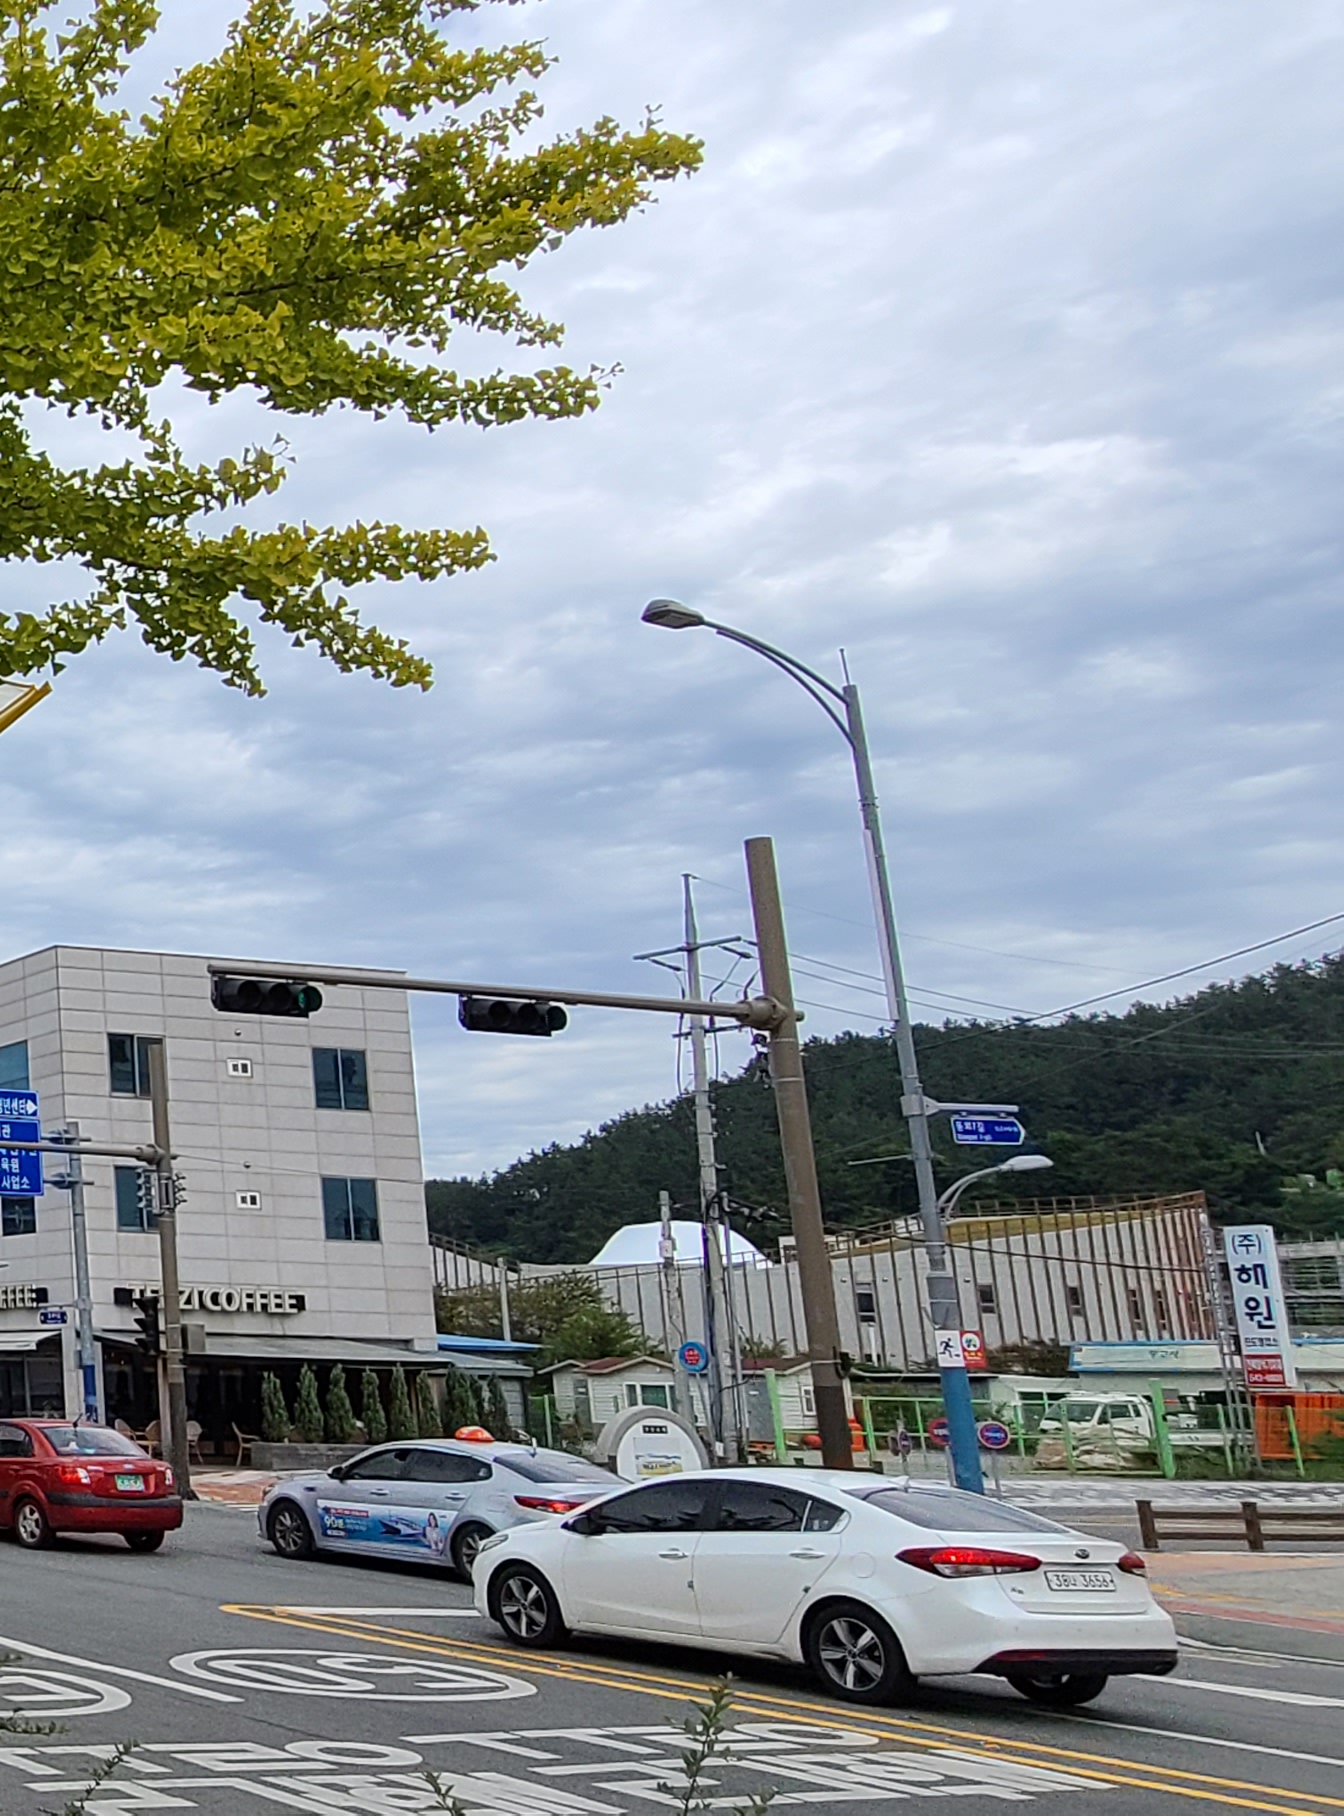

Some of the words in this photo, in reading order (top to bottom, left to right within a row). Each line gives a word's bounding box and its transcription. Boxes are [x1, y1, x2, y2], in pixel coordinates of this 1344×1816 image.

[1, 1175, 30, 1190] 사업소
[1231, 1233, 1262, 1255] (주)
[203, 1286, 299, 1313] COFFEE
